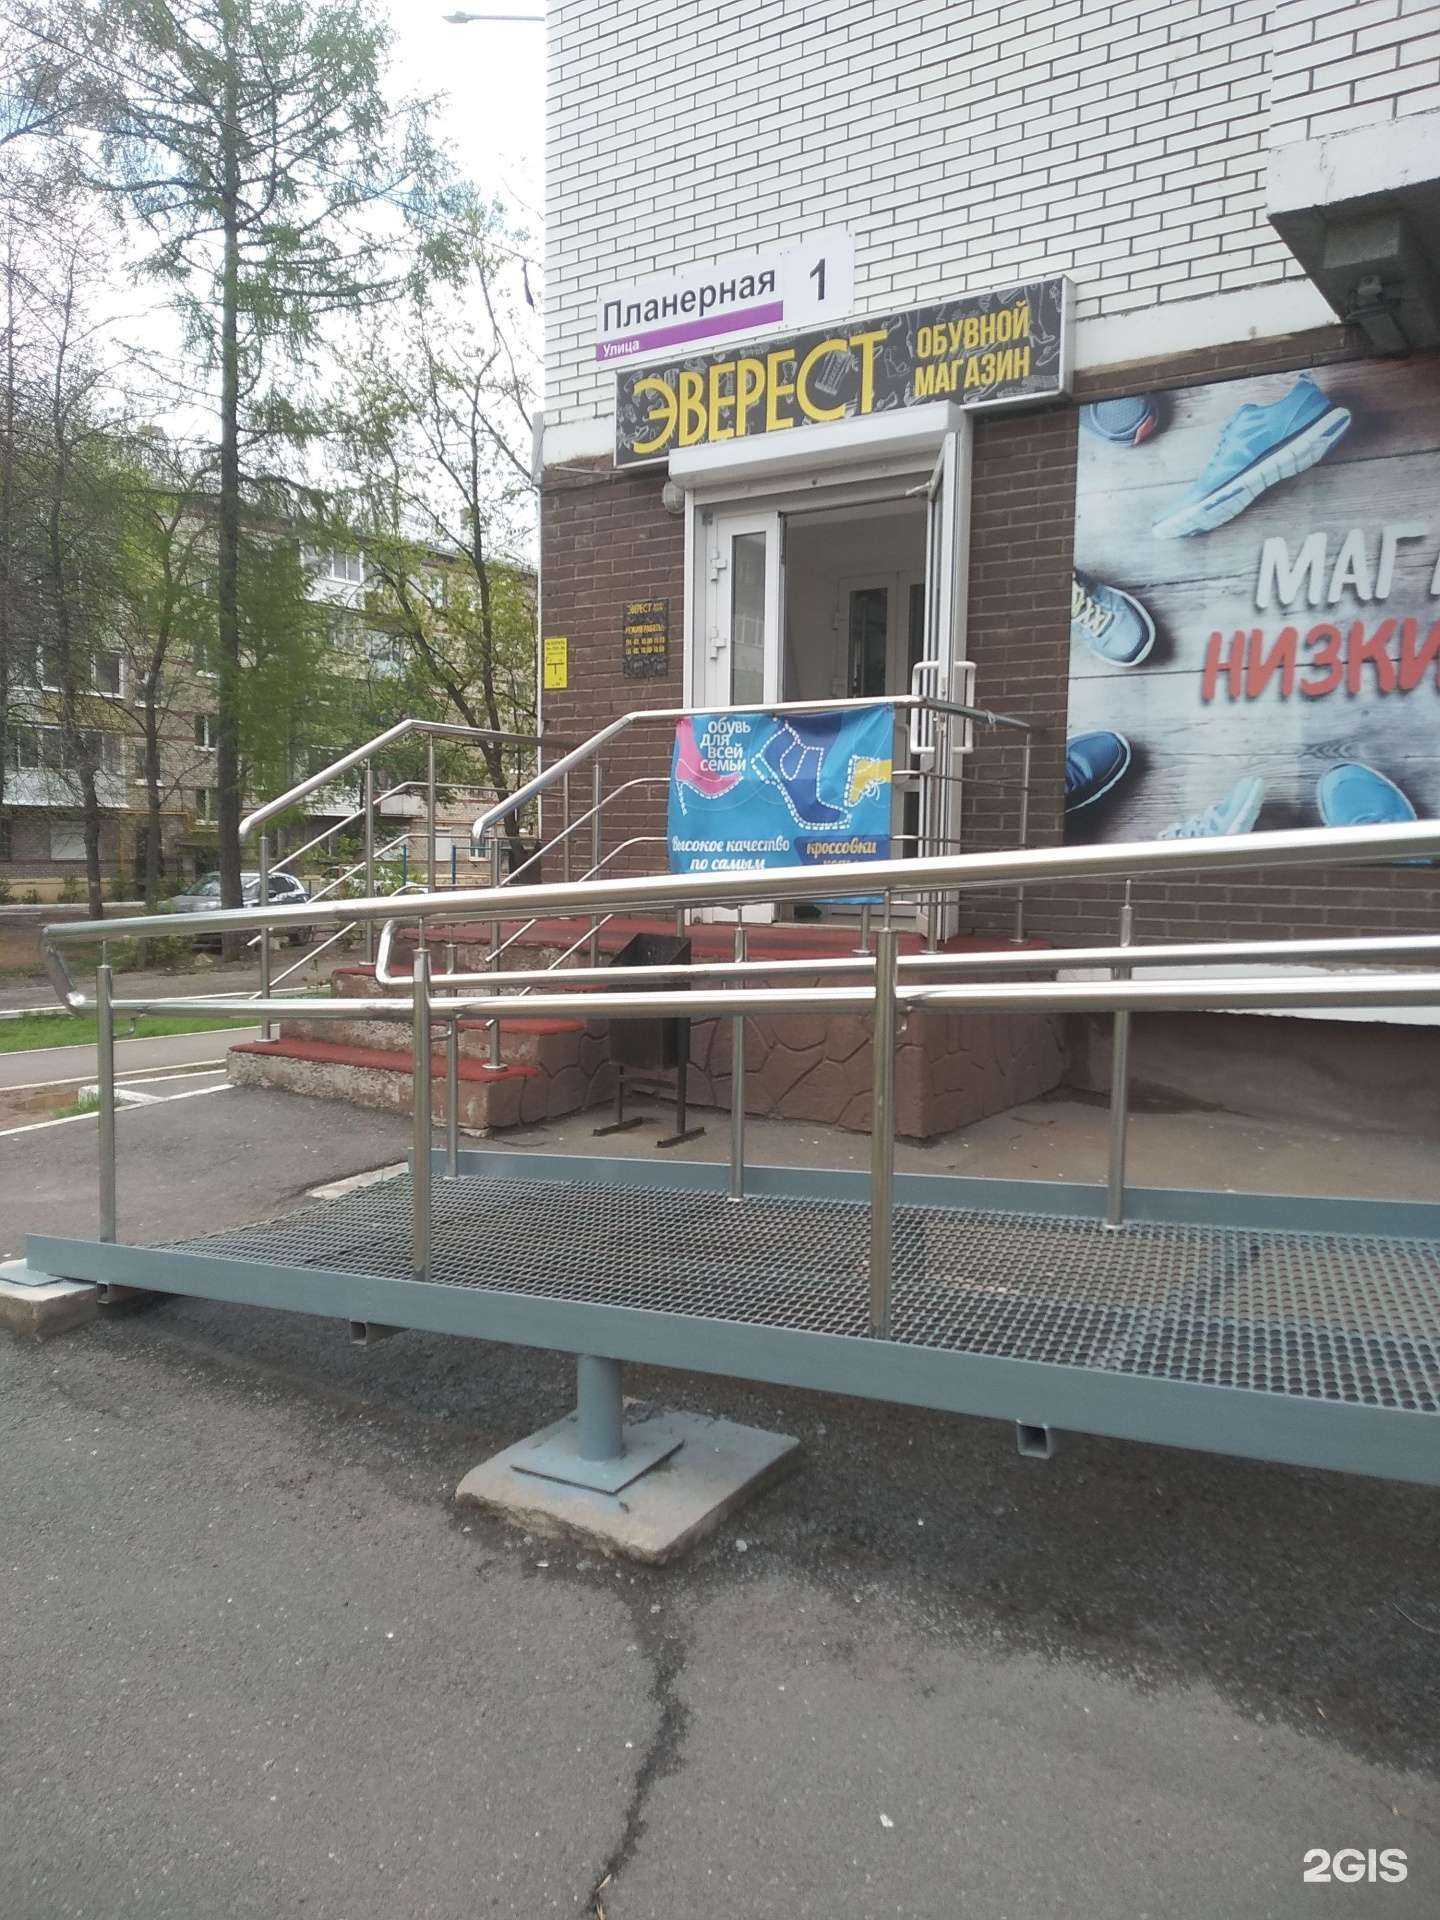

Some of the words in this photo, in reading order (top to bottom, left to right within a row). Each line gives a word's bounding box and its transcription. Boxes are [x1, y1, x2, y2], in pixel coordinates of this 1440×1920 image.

[603, 269, 775, 331] Планерная
[809, 258, 826, 301] 1
[917, 300, 1030, 359] ОБУВНОЙ
[602, 339, 640, 358] Улица
[914, 346, 1030, 397] МАГАЗИН
[633, 330, 888, 455] ЭВЕРЕСТ
[1255, 521, 1440, 609] МАГ
[700, 733, 730, 749] для
[708, 743, 744, 759] всей
[700, 759, 746, 772] семьи
[726, 835, 790, 852] качество
[806, 837, 877, 859] кроссовки
[690, 858, 708, 871] по
[711, 858, 766, 871] самым
